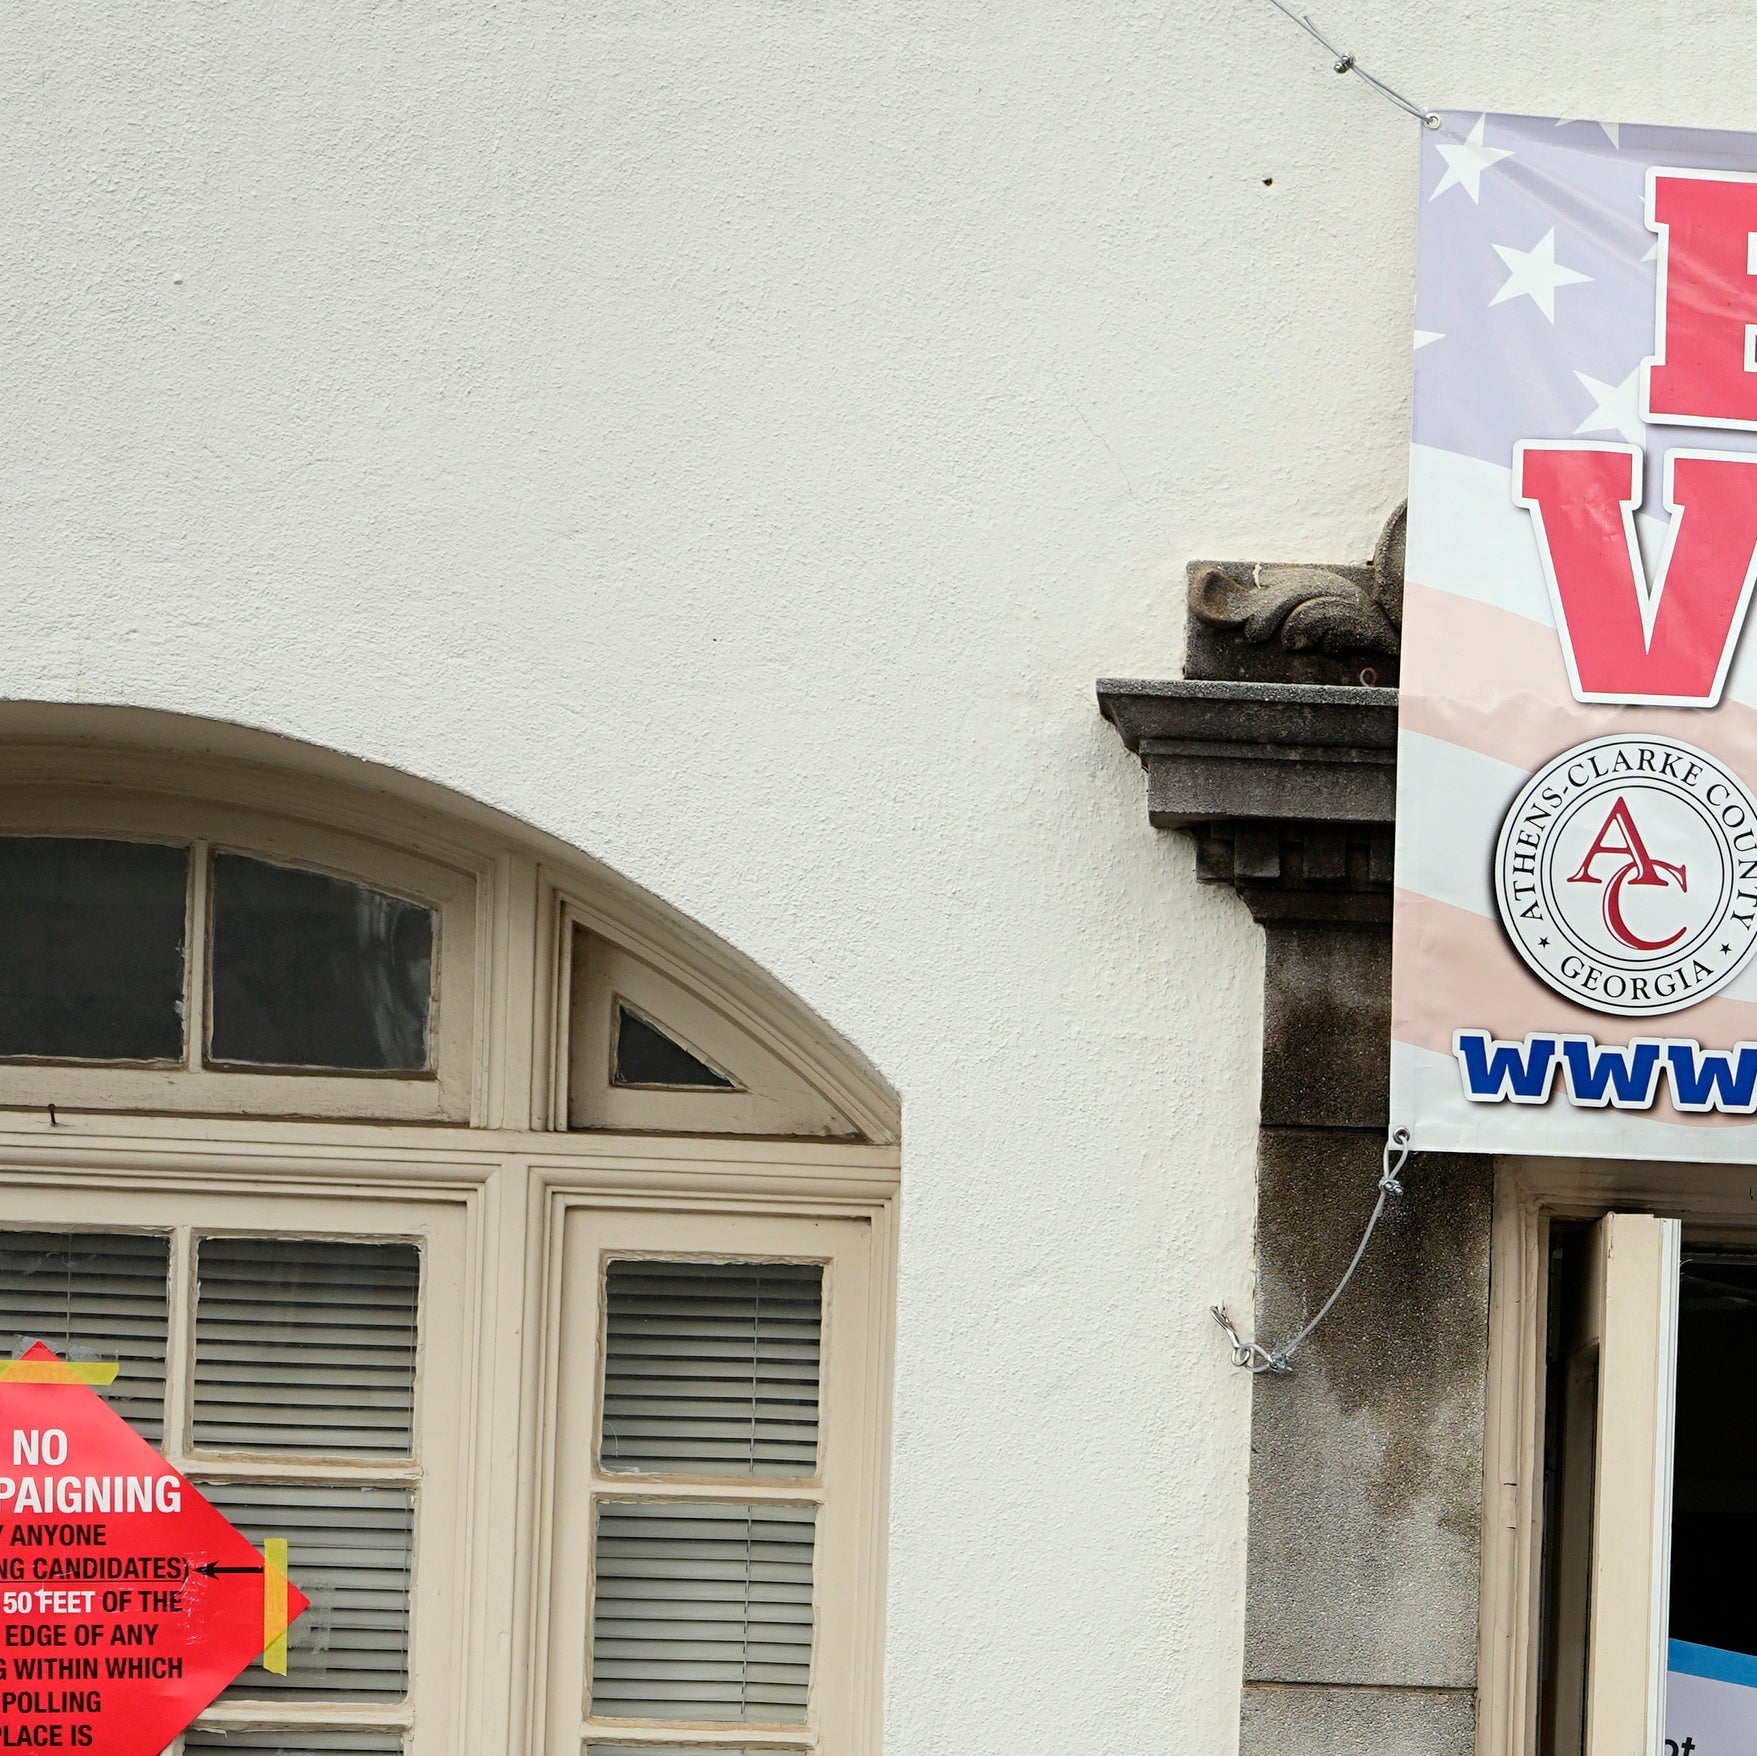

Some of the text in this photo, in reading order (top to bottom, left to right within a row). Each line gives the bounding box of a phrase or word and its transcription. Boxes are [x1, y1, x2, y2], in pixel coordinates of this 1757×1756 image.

[1512, 748, 1703, 922] ATHENS-CLARKE
[1560, 955, 1714, 1000] GEORGIA
[13, 1428, 68, 1466] NO
[10, 1524, 107, 1546] ANYONE
[33, 1556, 190, 1584] CANDIDATES)
[3, 1590, 183, 1614] 50 FEET OF THE
[6, 1624, 159, 1647] EDGE OF ANY
[14, 1657, 99, 1680] WITHIN
[106, 1657, 183, 1680] WHICH
[2, 1691, 102, 1714] POLLING
[0, 1725, 93, 1747] LACE IS
